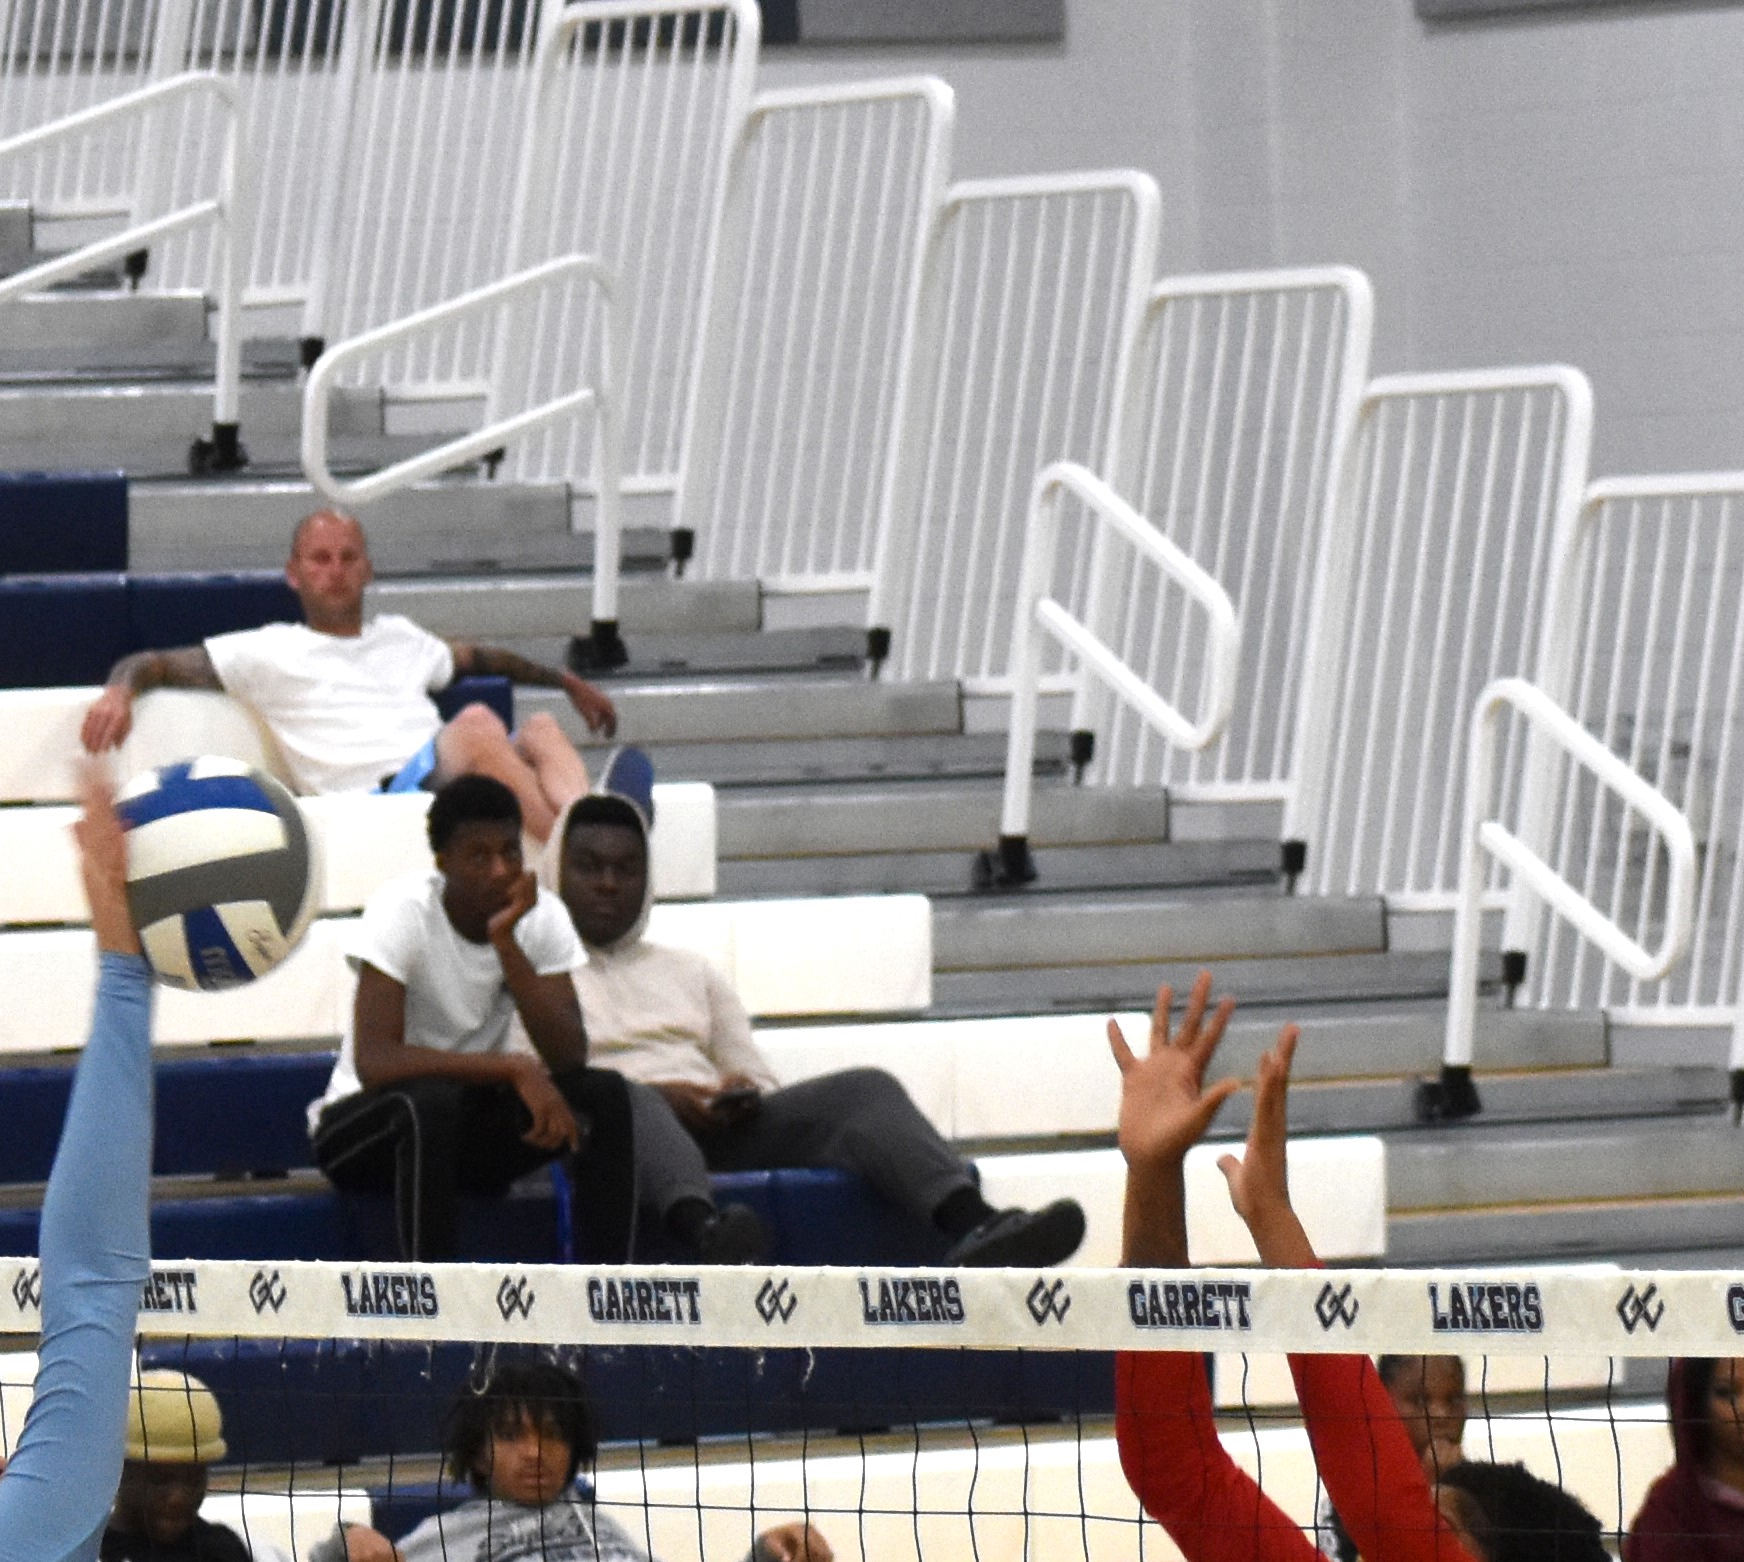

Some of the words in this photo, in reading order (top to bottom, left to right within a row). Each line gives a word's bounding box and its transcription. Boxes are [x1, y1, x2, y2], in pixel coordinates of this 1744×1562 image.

[139, 1269, 199, 1315] RETT
[340, 1274, 442, 1321] LAKERS
[586, 1277, 704, 1328] GARRETT
[857, 1277, 969, 1329] LAKERS
[1126, 1280, 1254, 1333] GARRETT
[1427, 1282, 1547, 1336] LAKERS
